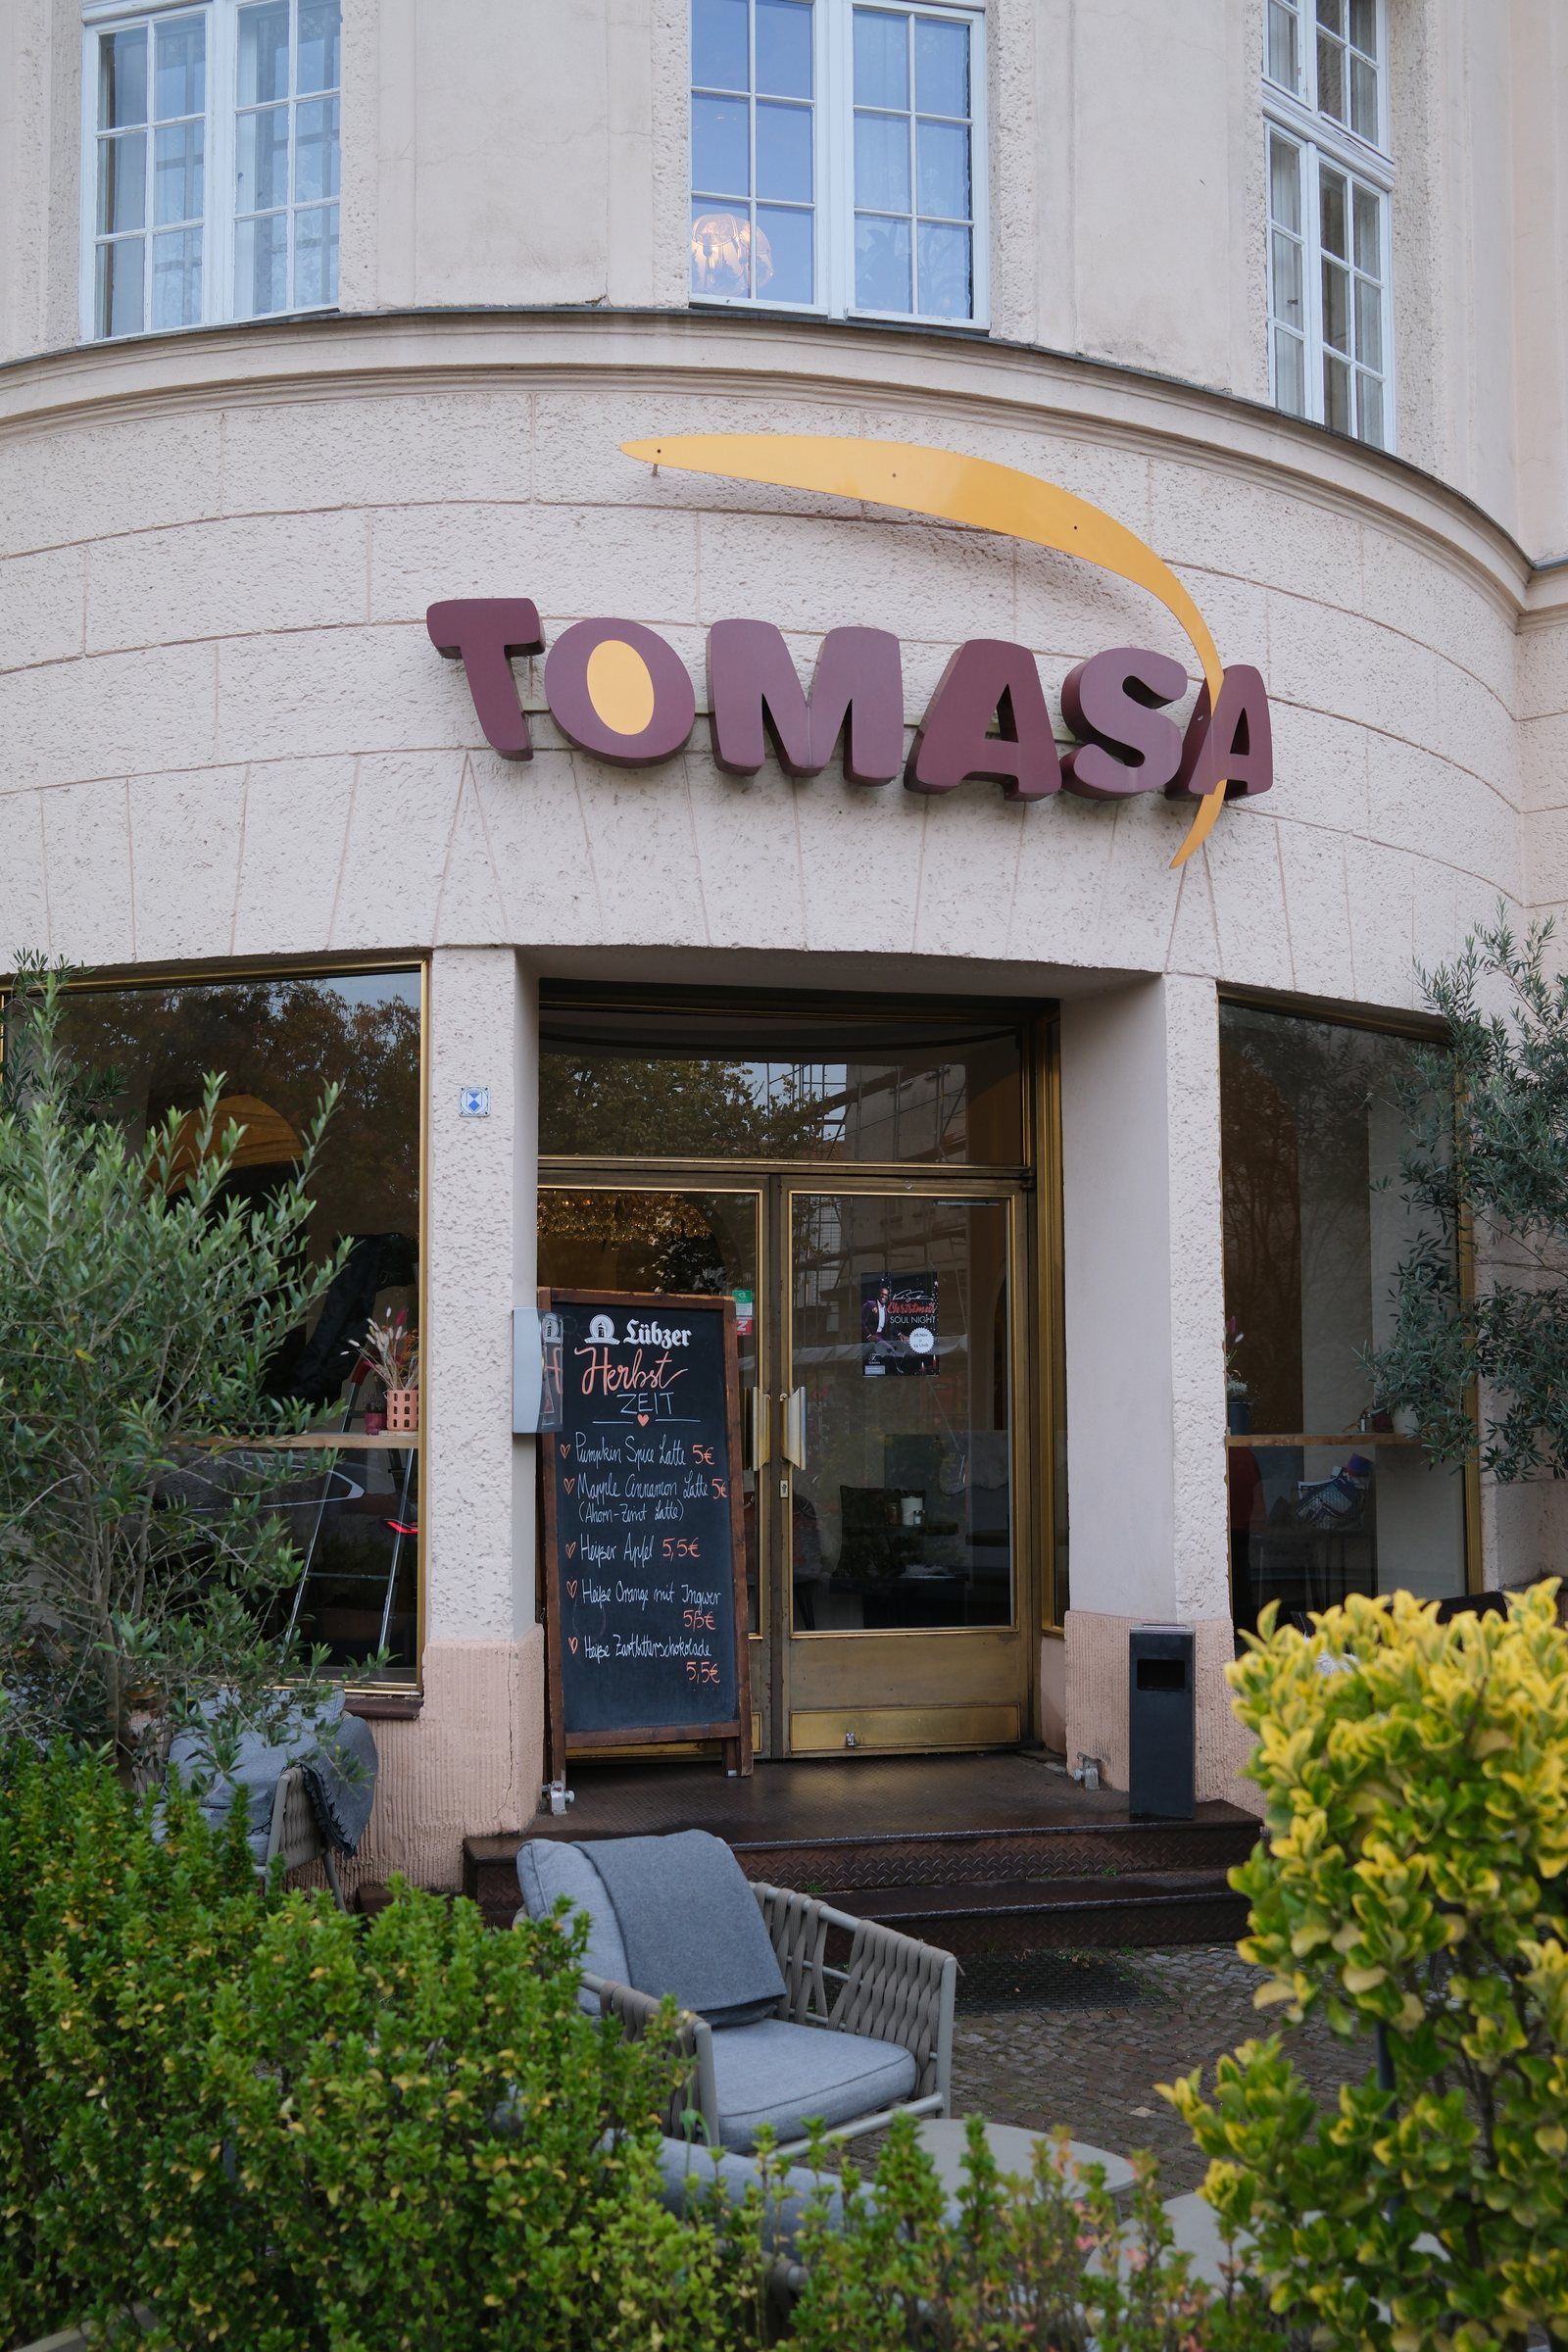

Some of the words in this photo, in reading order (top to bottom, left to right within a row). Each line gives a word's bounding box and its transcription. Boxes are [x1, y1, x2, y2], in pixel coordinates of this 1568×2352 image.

[426, 598, 1273, 801] TOMASA
[623, 1318, 693, 1349] Lübzer
[890, 1315, 908, 1324] SOUL
[911, 1315, 935, 1324] NIGHT
[574, 1346, 689, 1396] Herbst
[616, 1392, 674, 1415] ZEIT
[575, 1431, 622, 1469] Pumpkin
[624, 1435, 655, 1471] Spice
[659, 1434, 687, 1466] Latte
[692, 1445, 715, 1465] 5€
[625, 1473, 677, 1498] Cinnamon
[683, 1470, 709, 1498] Latte
[711, 1478, 728, 1499] 5€
[655, 1498, 684, 1521] Latte)
[580, 1533, 617, 1568] Heißer
[623, 1532, 655, 1568] Apfel
[662, 1538, 701, 1562] 5,5€
[582, 1578, 611, 1609] Heiße
[615, 1580, 649, 1611] Orange
[654, 1582, 675, 1603] mit
[681, 1584, 721, 1615] Ingwer
[584, 1635, 610, 1664] Heiße
[686, 1661, 720, 1684] 5,5€
